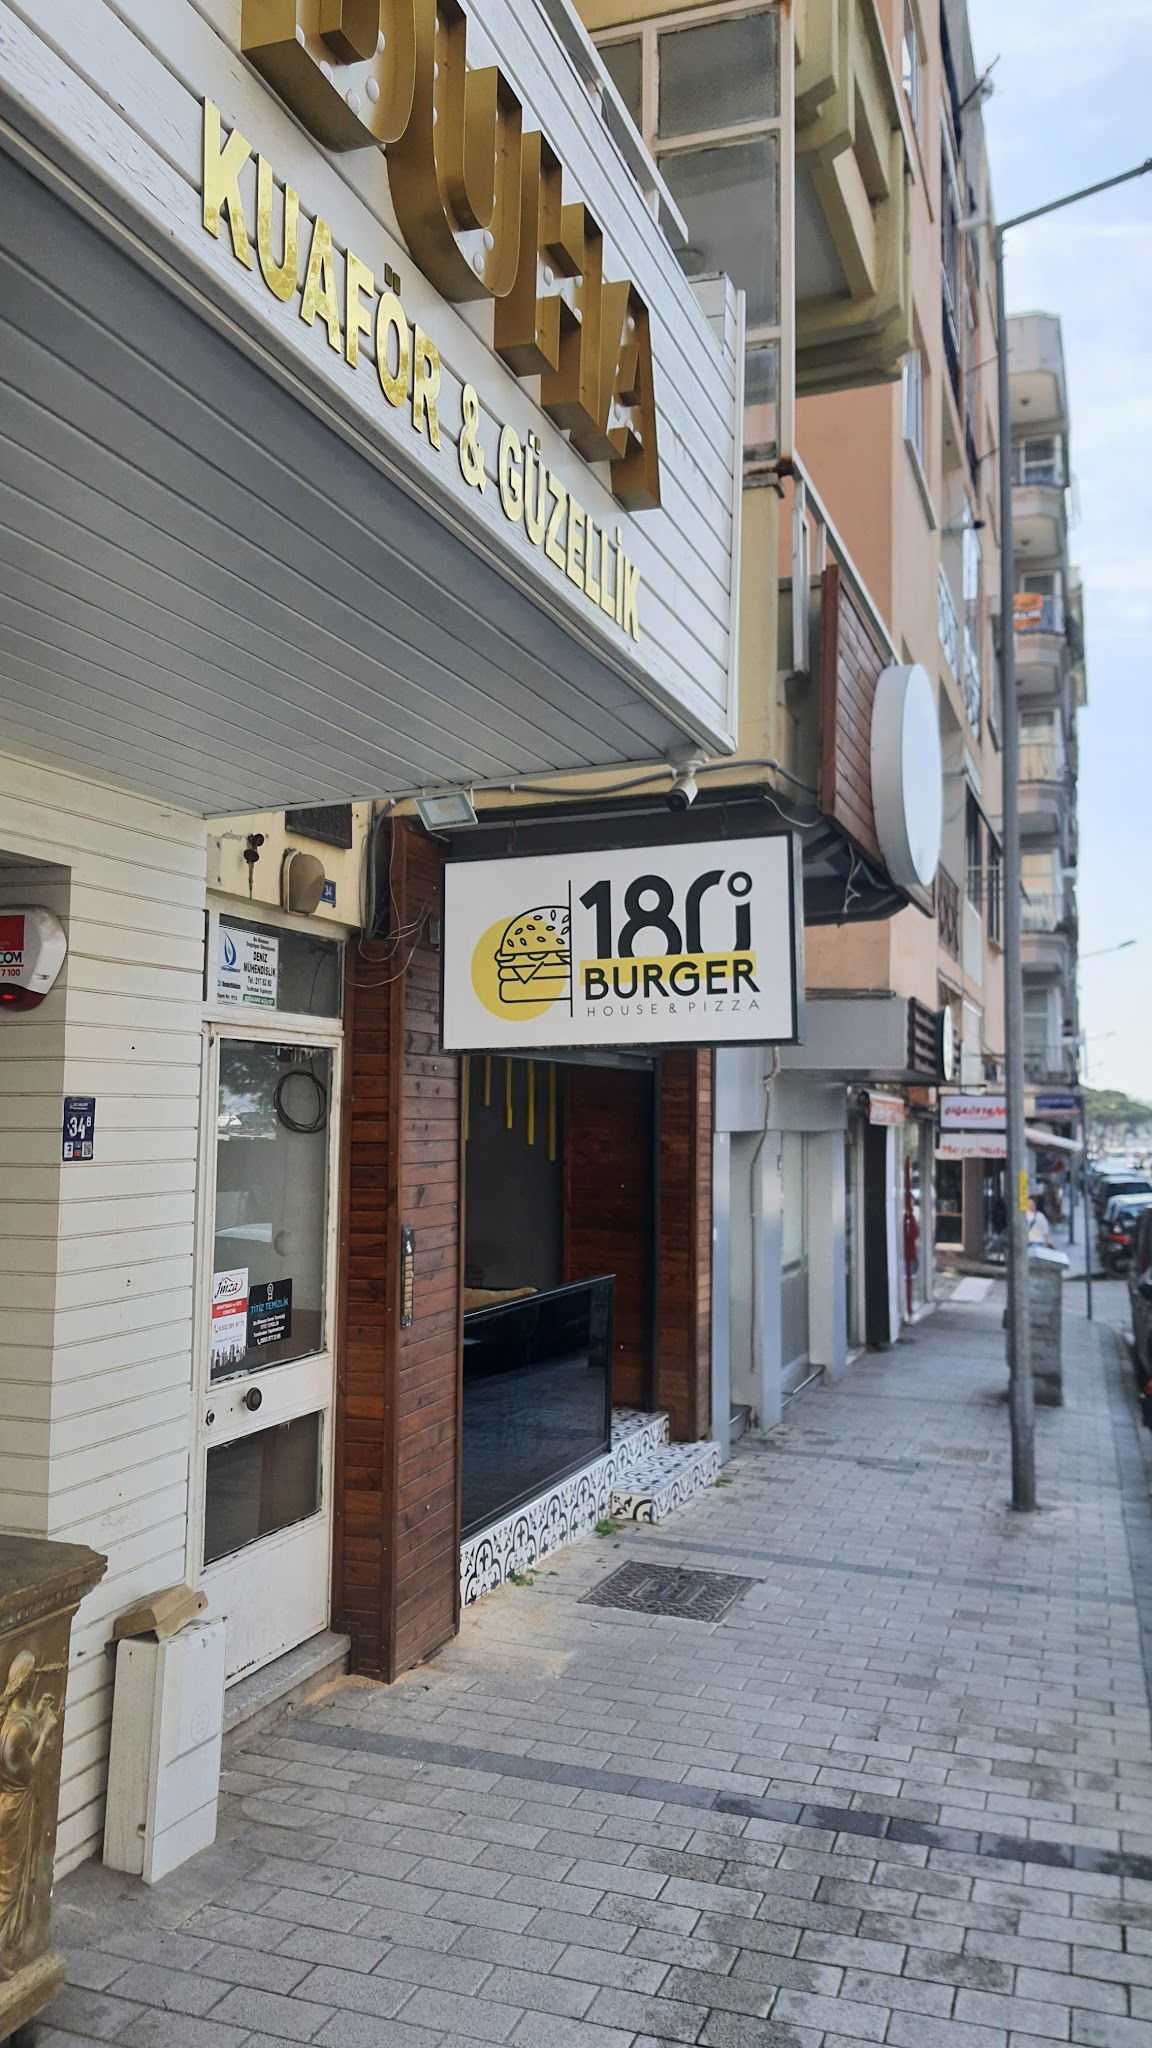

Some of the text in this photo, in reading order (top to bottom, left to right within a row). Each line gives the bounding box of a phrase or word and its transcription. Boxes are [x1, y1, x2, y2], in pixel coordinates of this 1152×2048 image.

[203, 97, 641, 643] KUAFÖR & GÜZELLİK
[324, 885, 333, 897] 34
[253, 951, 268, 963] DENİZ
[8, 968, 21, 977] 100
[243, 961, 277, 976] MÜHENDİSLİK
[585, 959, 760, 1000] BURGER
[587, 999, 760, 1017] HOUSE & PIZZA
[69, 1116, 86, 1140] 34
[251, 1297, 289, 1314] TİTİZ TEMİZLİK
